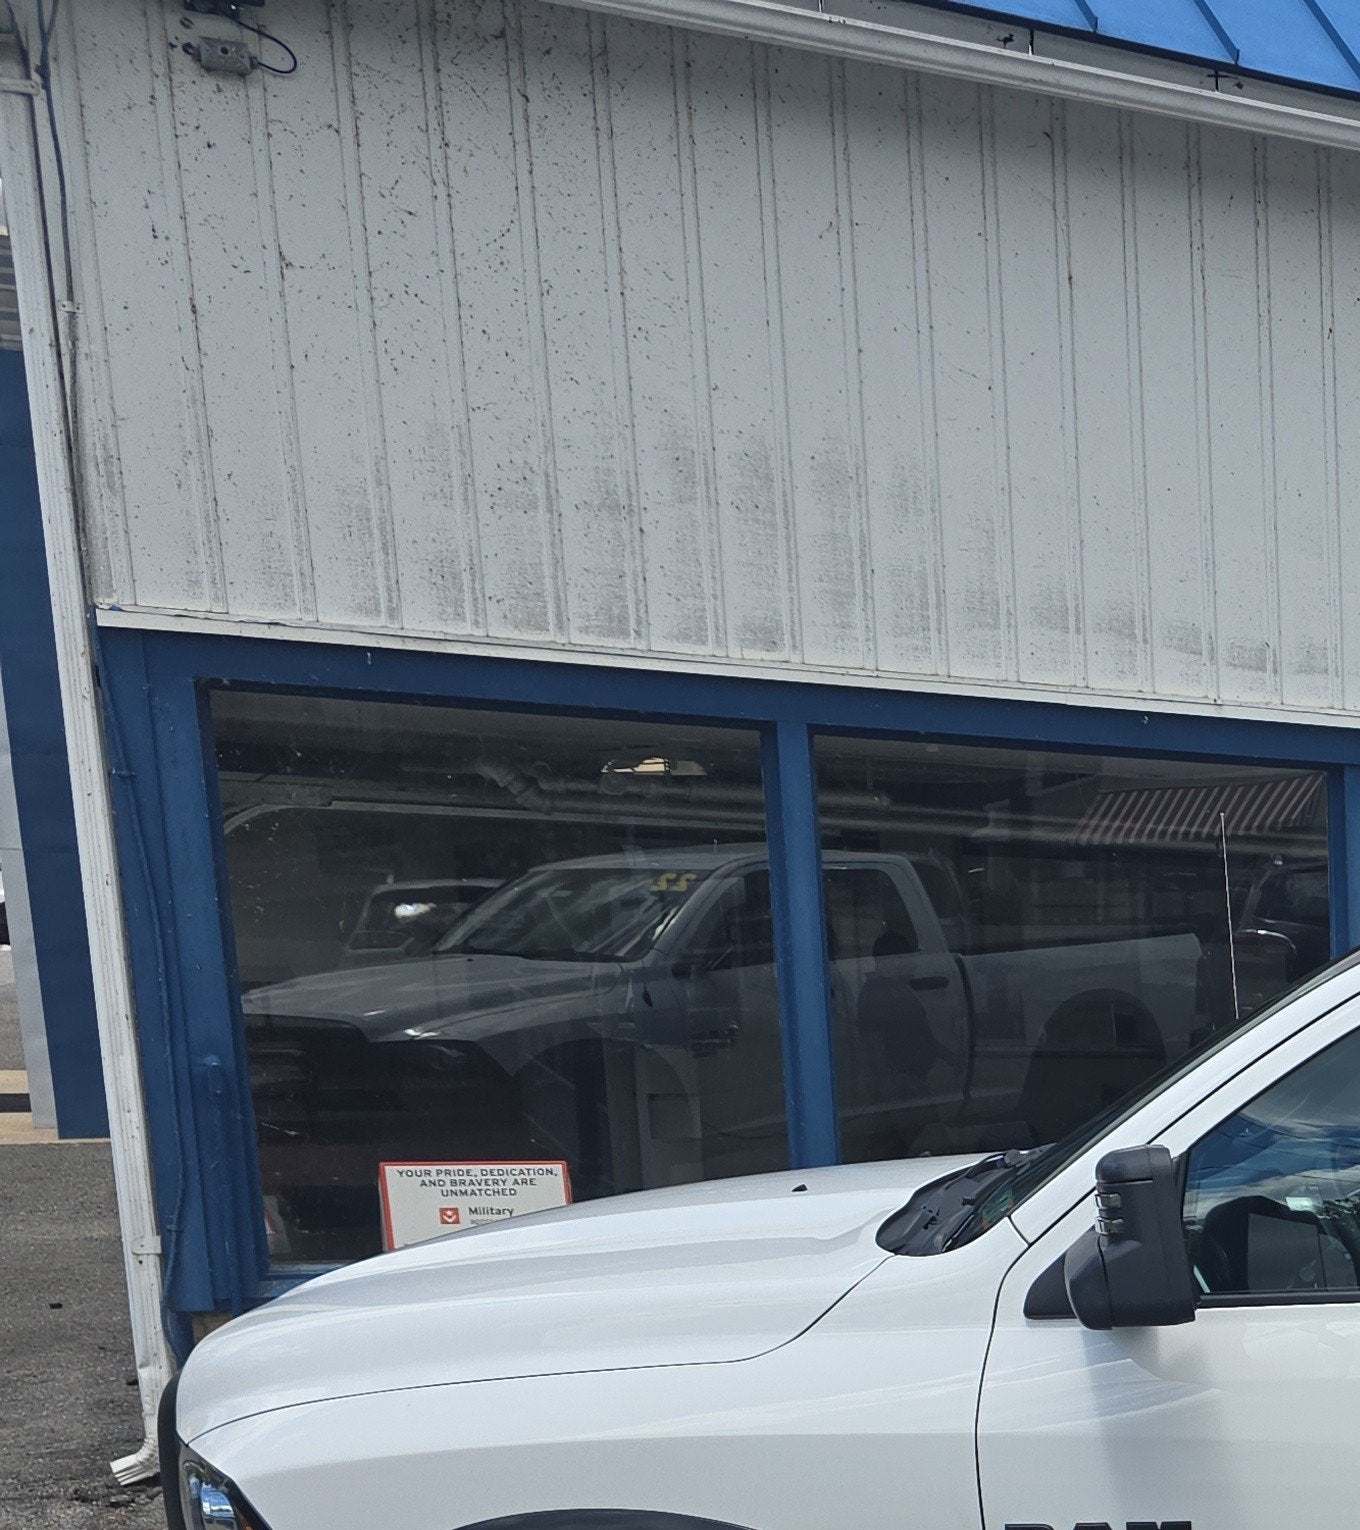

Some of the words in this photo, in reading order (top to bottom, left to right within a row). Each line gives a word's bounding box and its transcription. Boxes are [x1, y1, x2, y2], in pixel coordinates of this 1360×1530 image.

[397, 1169, 432, 1178] YOUR
[435, 1168, 478, 1178] PRIDE,
[480, 1167, 558, 1177] DEDICATION,
[419, 1178, 446, 1188] AND
[449, 1178, 507, 1187] BRAVERY
[512, 1177, 538, 1187] ARE
[440, 1188, 517, 1198] UNMATCHED
[468, 1206, 514, 1219] Military
